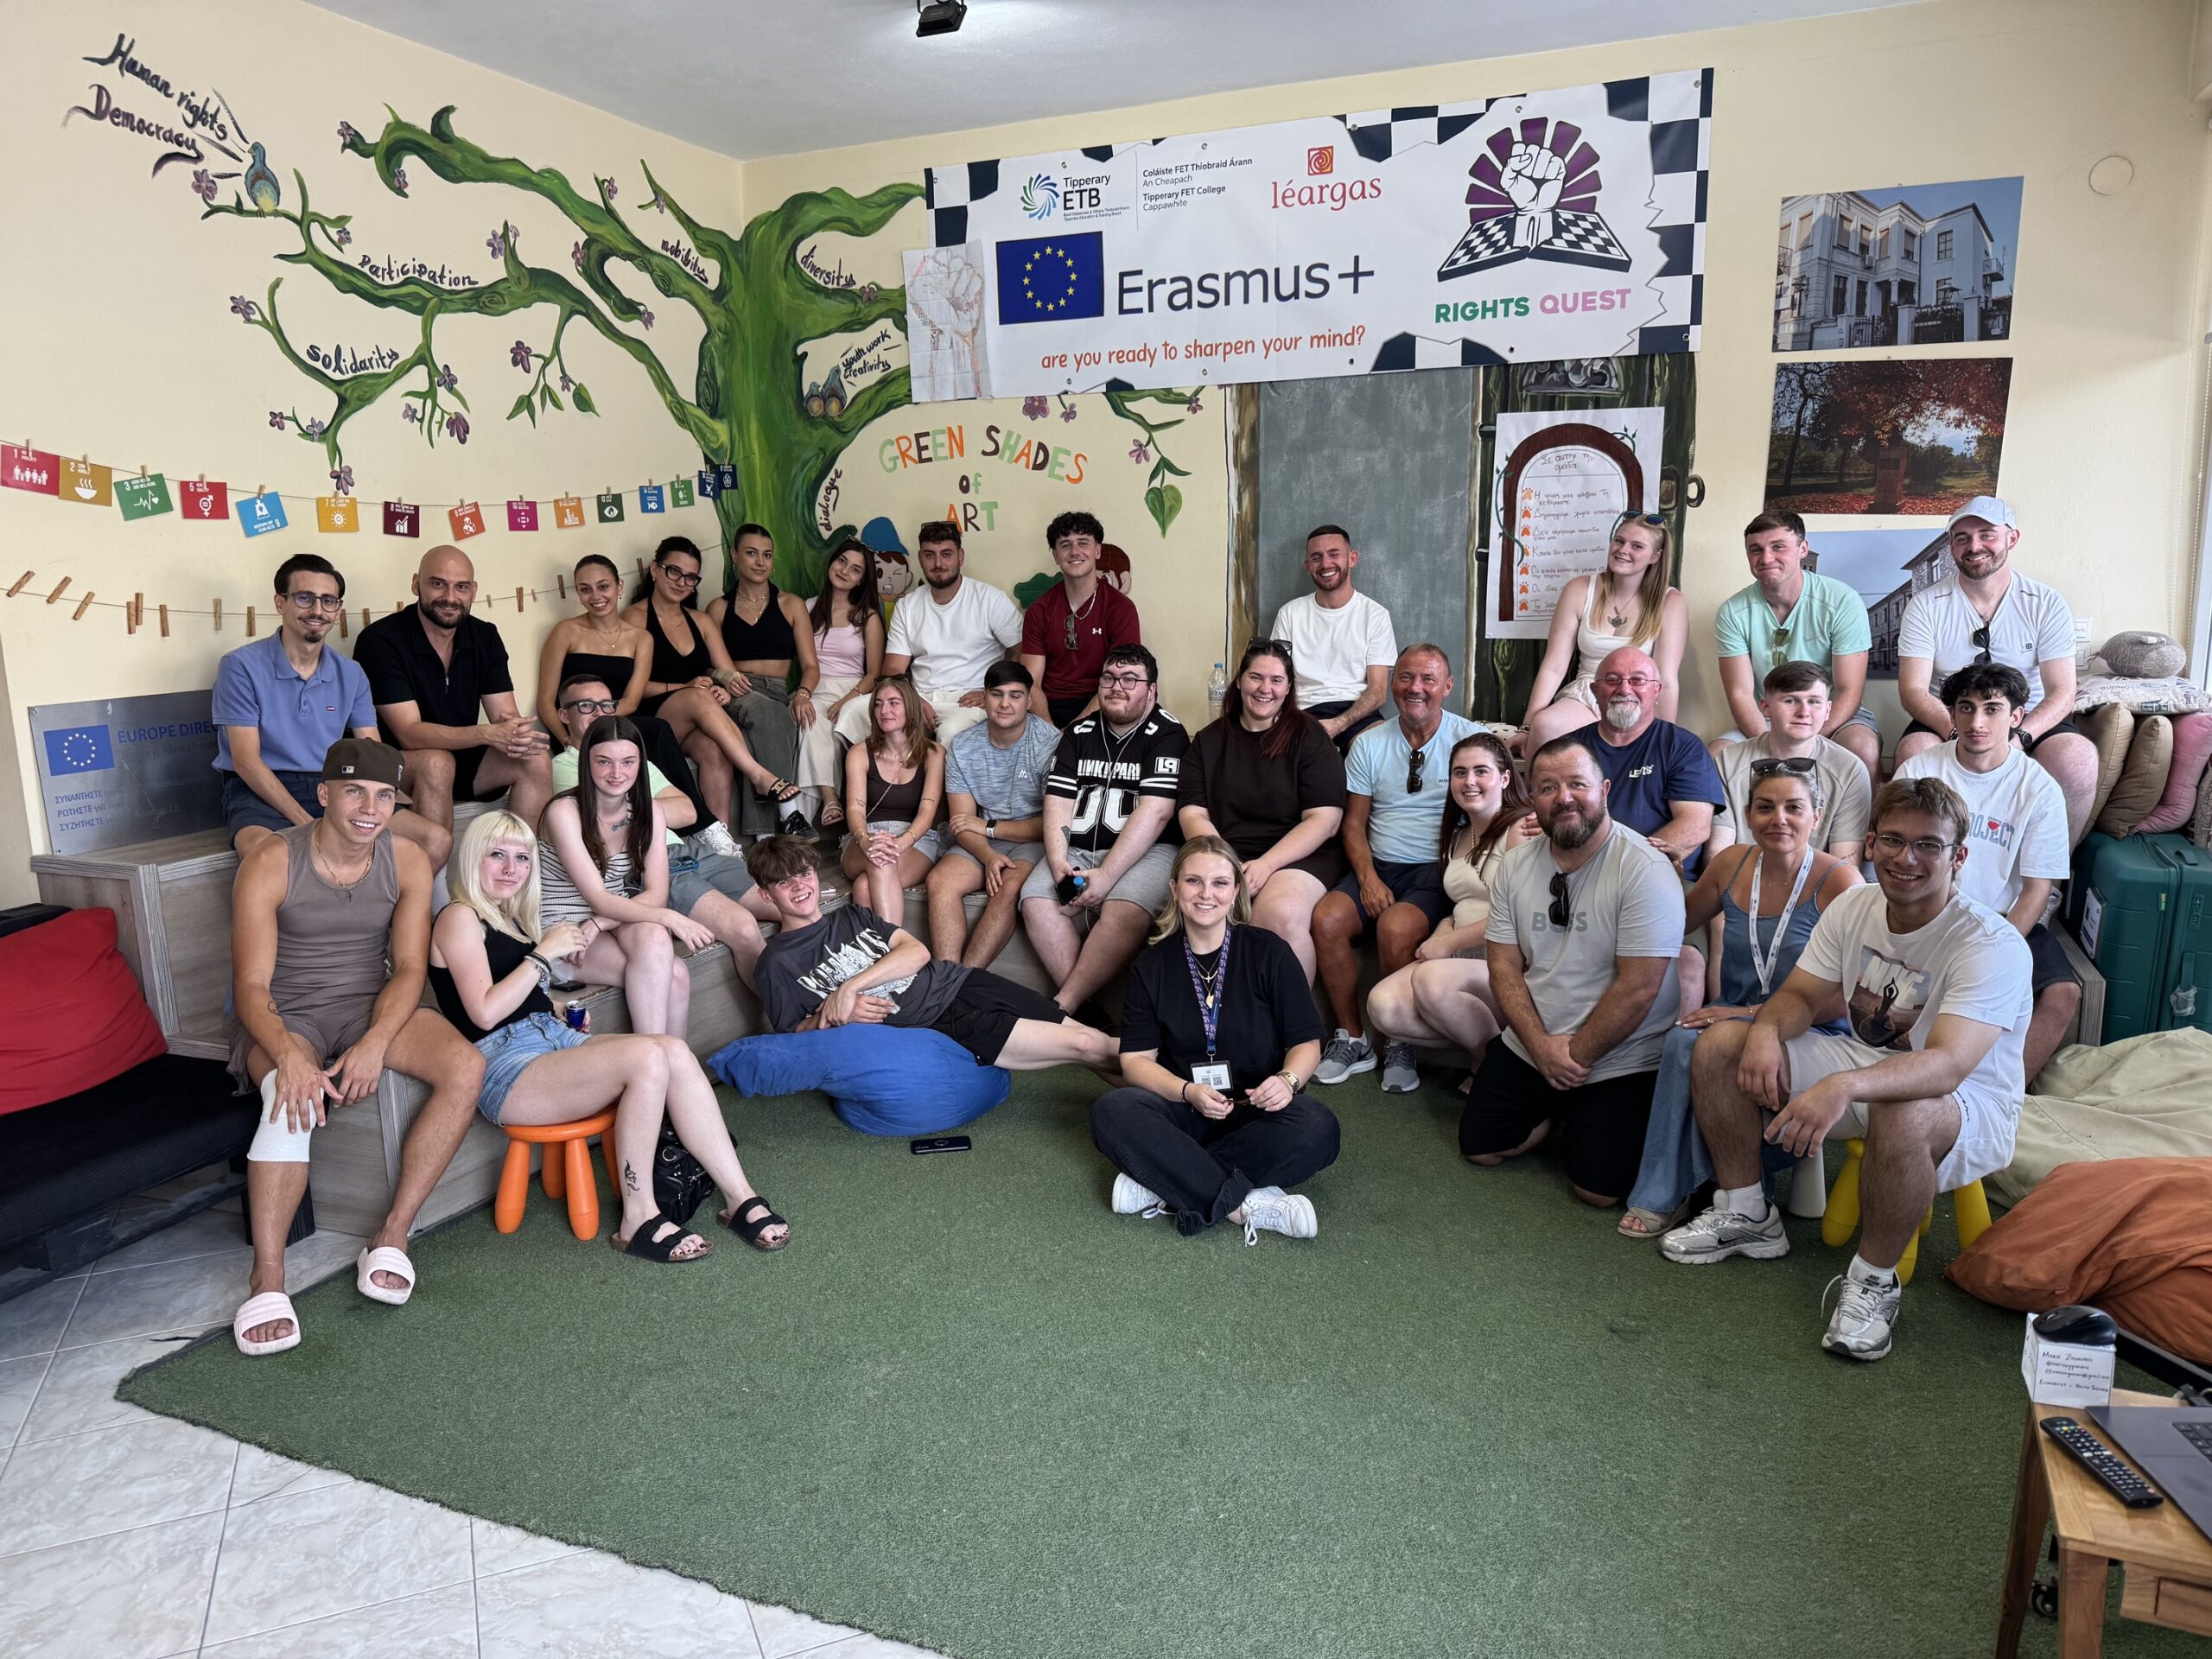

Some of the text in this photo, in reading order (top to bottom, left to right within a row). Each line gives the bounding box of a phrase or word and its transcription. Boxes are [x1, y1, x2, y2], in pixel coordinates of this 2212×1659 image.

[82, 33, 228, 141] Human rights
[61, 84, 205, 179] Democracy
[1142, 157, 1253, 178] Coláiste FET Thiobraid Árann
[1142, 174, 1193, 188] An Cheapach
[1063, 175, 1111, 190] Tipperary
[1142, 185, 1226, 202] Tipperary FET College
[1271, 179, 1382, 212] léargas
[1063, 188, 1102, 211] ETB
[1142, 199, 1188, 212] Cappawhite
[358, 253, 480, 288] Participation
[800, 244, 857, 289] diversity
[1117, 255, 1375, 315] Erasmus+
[1434, 288, 1632, 324] RIGHTS QUEST
[866, 328, 891, 353] work
[1041, 324, 1366, 372] are you ready to sharpen your mind?
[13, 448, 18, 459] 1
[69, 461, 75, 473] 2
[879, 424, 1088, 485] GREEN SHADES
[124, 480, 130, 492] 3
[818, 468, 843, 531] dialogue
[946, 501, 999, 533] ART
[118, 724, 176, 743] EUROPE
